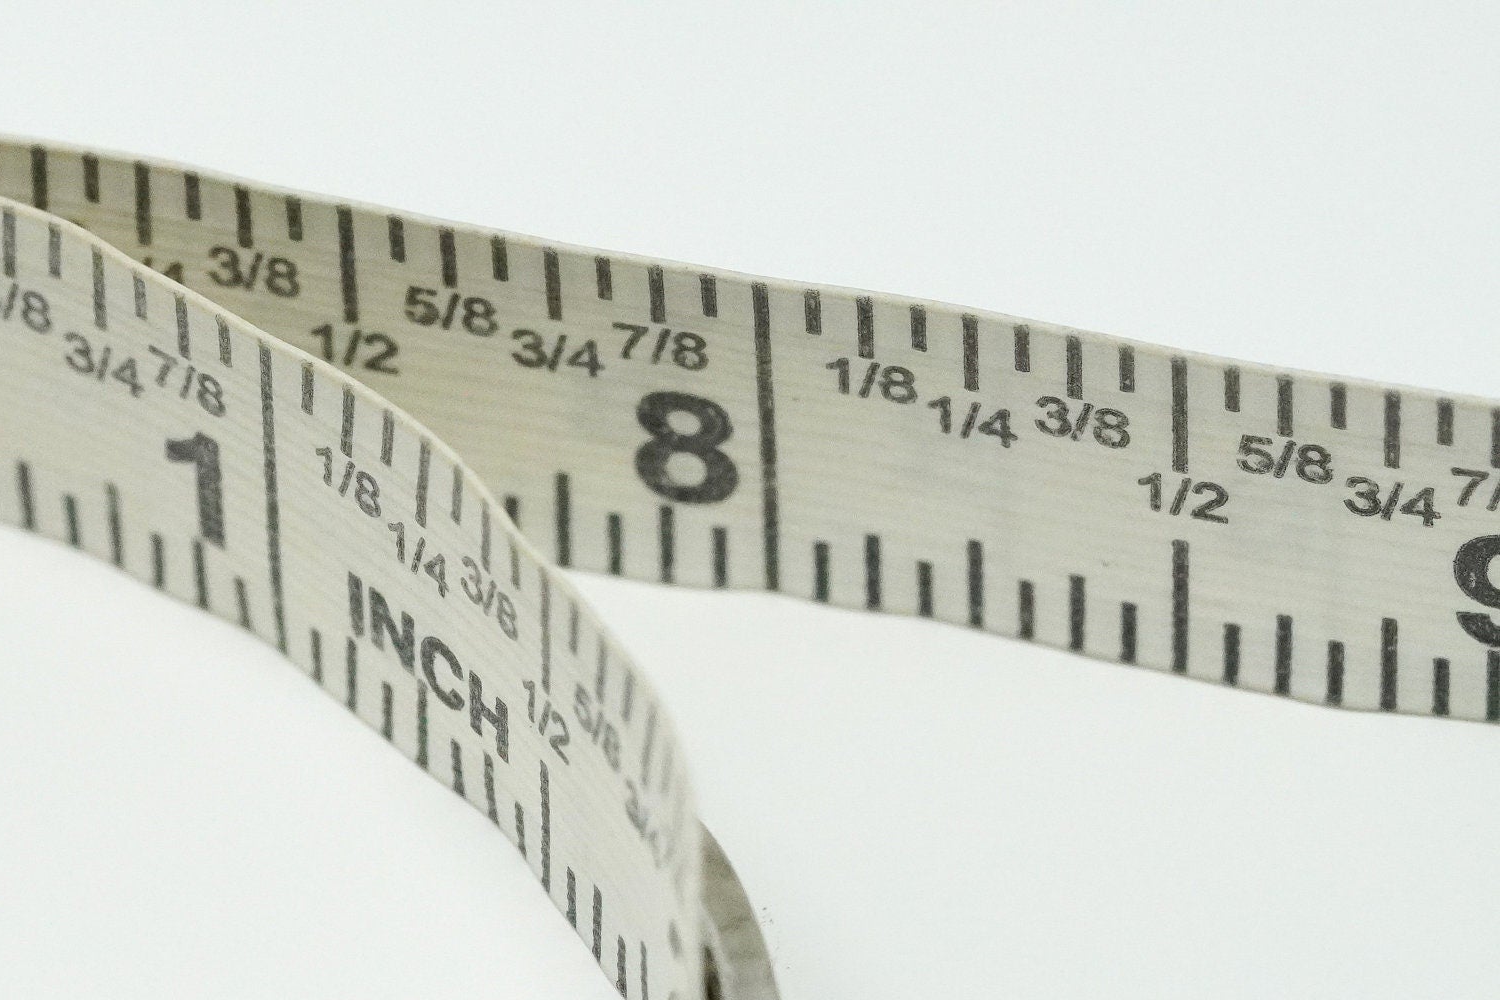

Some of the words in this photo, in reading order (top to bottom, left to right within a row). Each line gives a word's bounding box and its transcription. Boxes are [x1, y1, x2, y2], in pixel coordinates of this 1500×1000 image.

[206, 245, 300, 297] 3/8
[405, 286, 500, 338] 5/8
[64, 332, 145, 399] 3/4
[311, 324, 400, 375] 1/2
[511, 330, 605, 377] 3/4
[611, 323, 709, 371] 7/8
[149, 344, 227, 418] 7/8
[826, 357, 918, 404] 1/8
[634, 390, 737, 504] 8
[928, 396, 1018, 448] 1/4
[1035, 396, 1131, 449] 3/8
[316, 446, 381, 518] 1/8
[1236, 434, 1333, 484] 5/8
[166, 432, 225, 549] 1
[1137, 472, 1229, 524] 1/2
[1344, 477, 1441, 526] 3/4
[1451, 467, 1500, 511] 7/
[388, 521, 449, 598] 1/4
[460, 556, 518, 641] 3/8
[347, 571, 509, 763] INCH
[523, 680, 570, 766] 1/2
